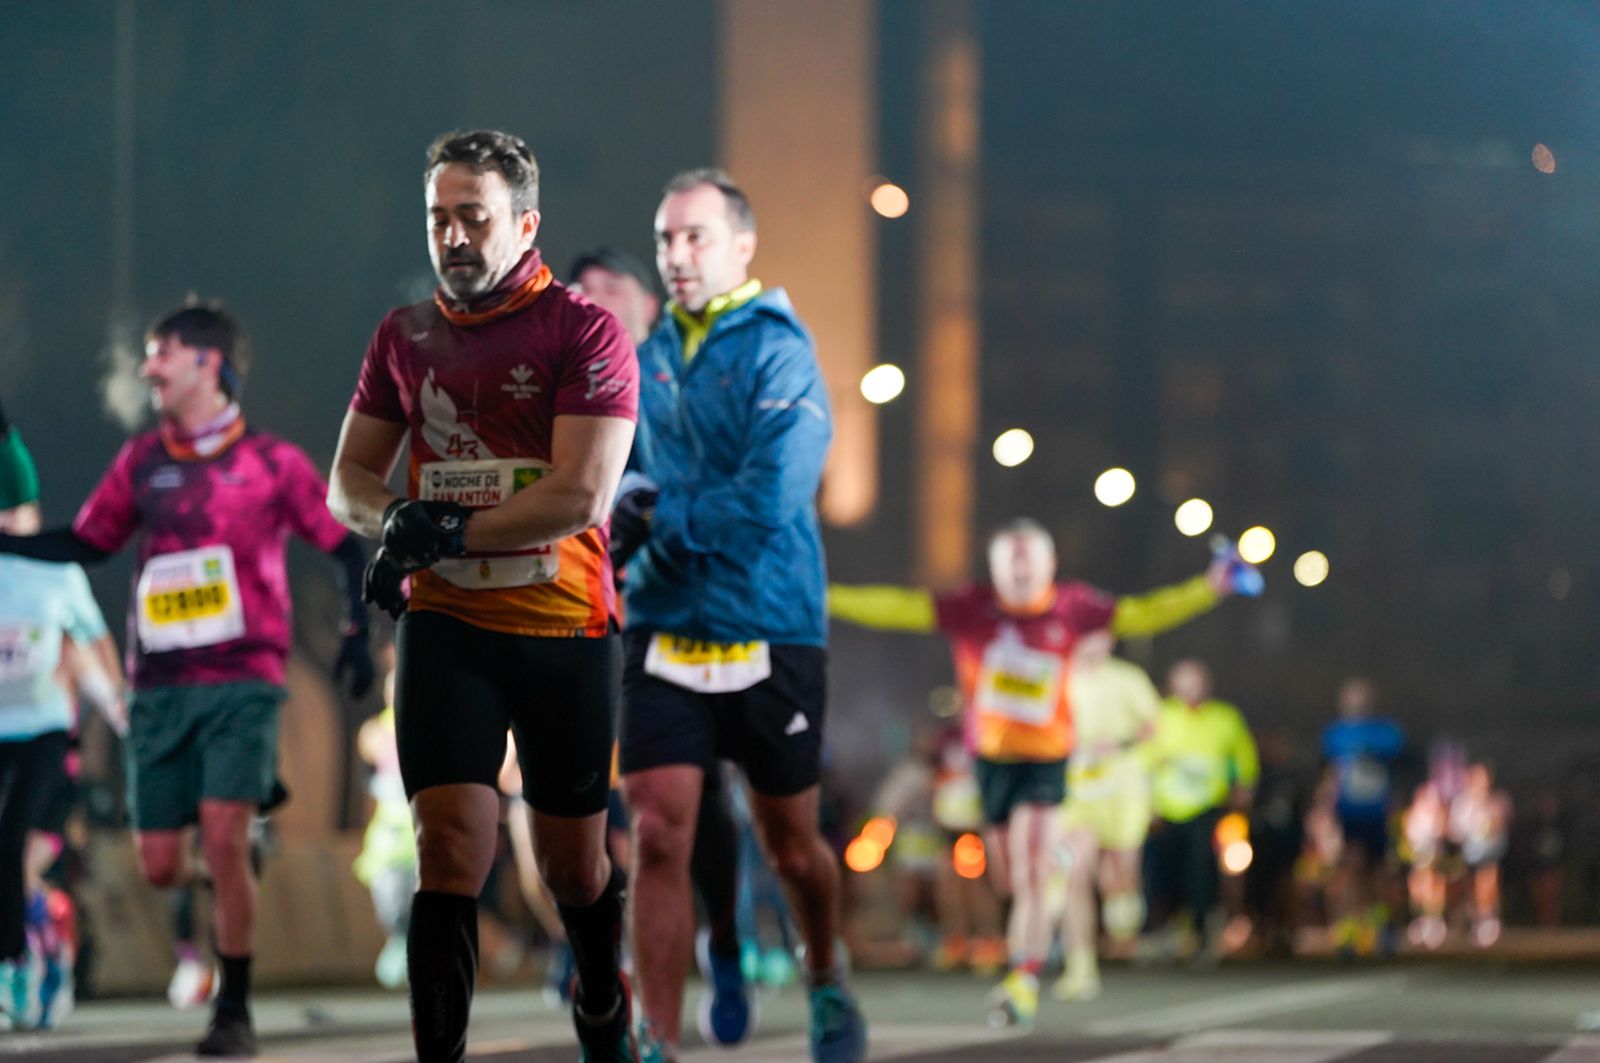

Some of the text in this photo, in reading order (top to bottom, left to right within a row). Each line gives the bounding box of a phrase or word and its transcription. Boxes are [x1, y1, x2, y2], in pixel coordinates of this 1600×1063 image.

[445, 433, 479, 460] 43
[443, 475, 482, 488] NOCHE
[485, 474, 501, 487] DE
